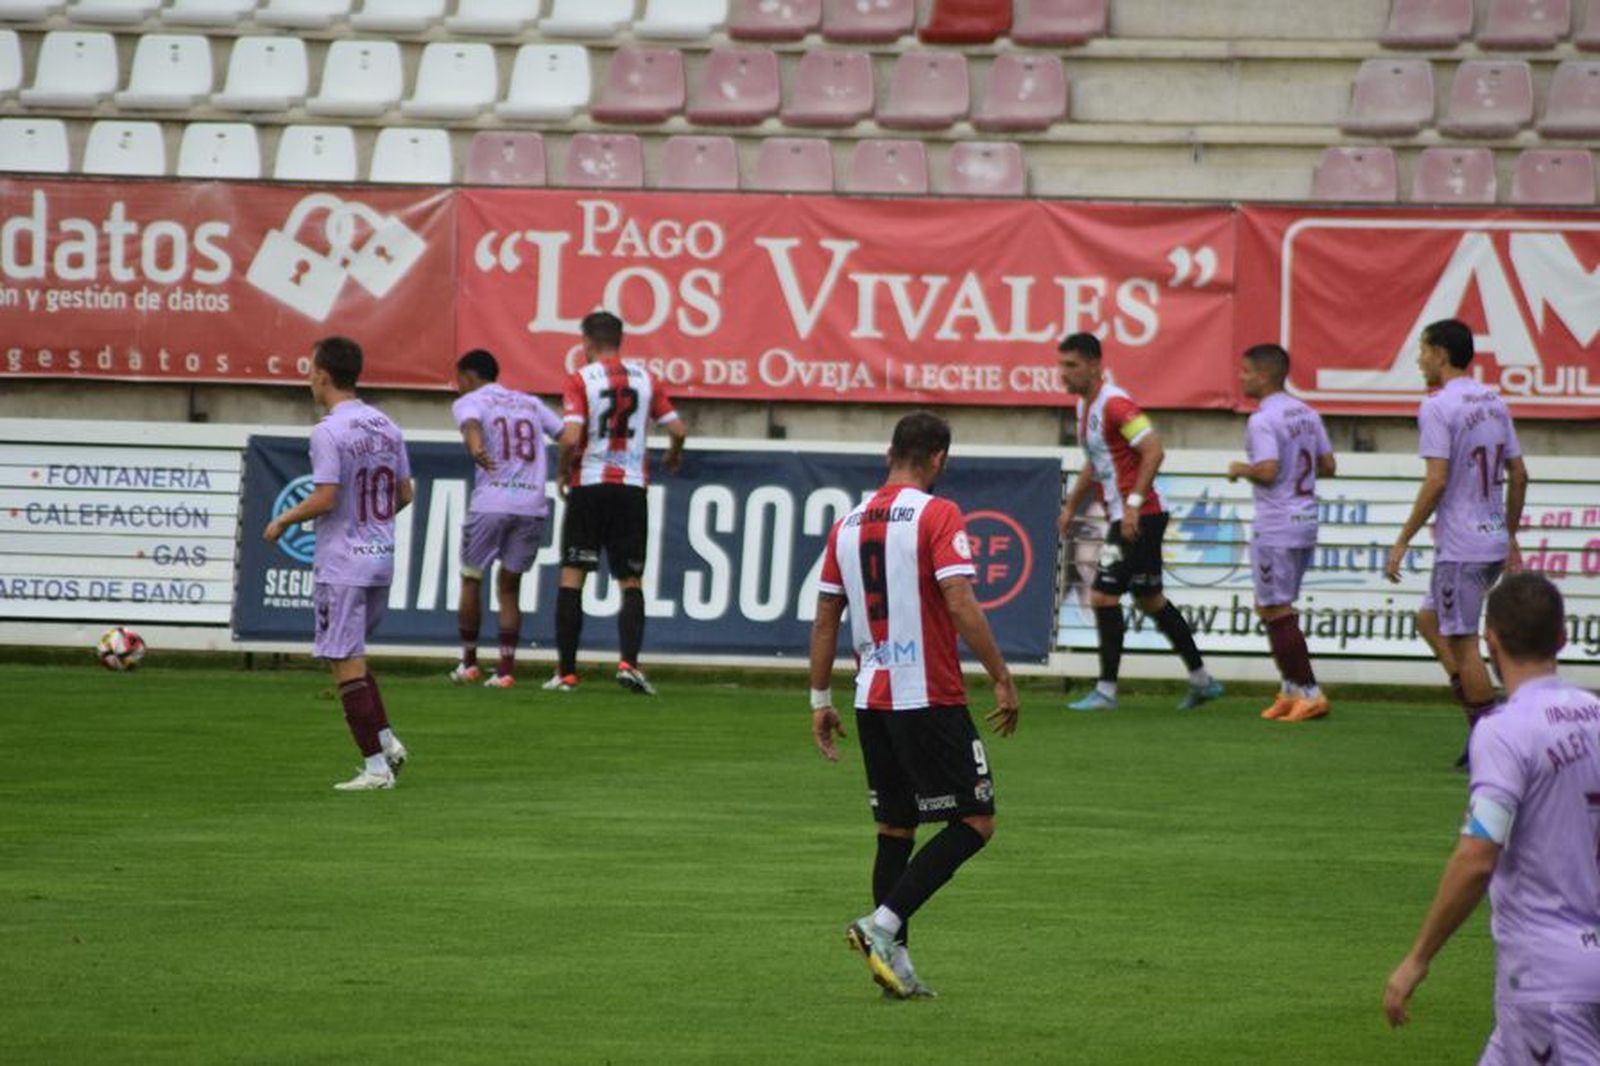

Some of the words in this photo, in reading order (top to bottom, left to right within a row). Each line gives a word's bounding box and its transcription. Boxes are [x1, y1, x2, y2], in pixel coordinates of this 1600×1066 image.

[1, 188, 233, 285] datos
[577, 199, 726, 260] PAGO
[26, 288, 39, 312] y
[46, 284, 123, 313] gestión
[134, 287, 160, 311] de
[167, 287, 229, 312] datos
[704, 359, 748, 386] DE
[758, 348, 874, 392] OVEJA
[904, 362, 1004, 392] LECHE
[597, 387, 639, 438] 22
[493, 416, 536, 462] 18
[47, 463, 211, 489] FONTANERÍA
[356, 465, 395, 526] 10
[26, 502, 209, 529] CALEFACCIÓN
[153, 545, 208, 567] GAS
[89, 580, 123, 602] DE
[131, 579, 206, 604] BAÑO
[859, 540, 889, 619] 9
[972, 739, 988, 775] 9
